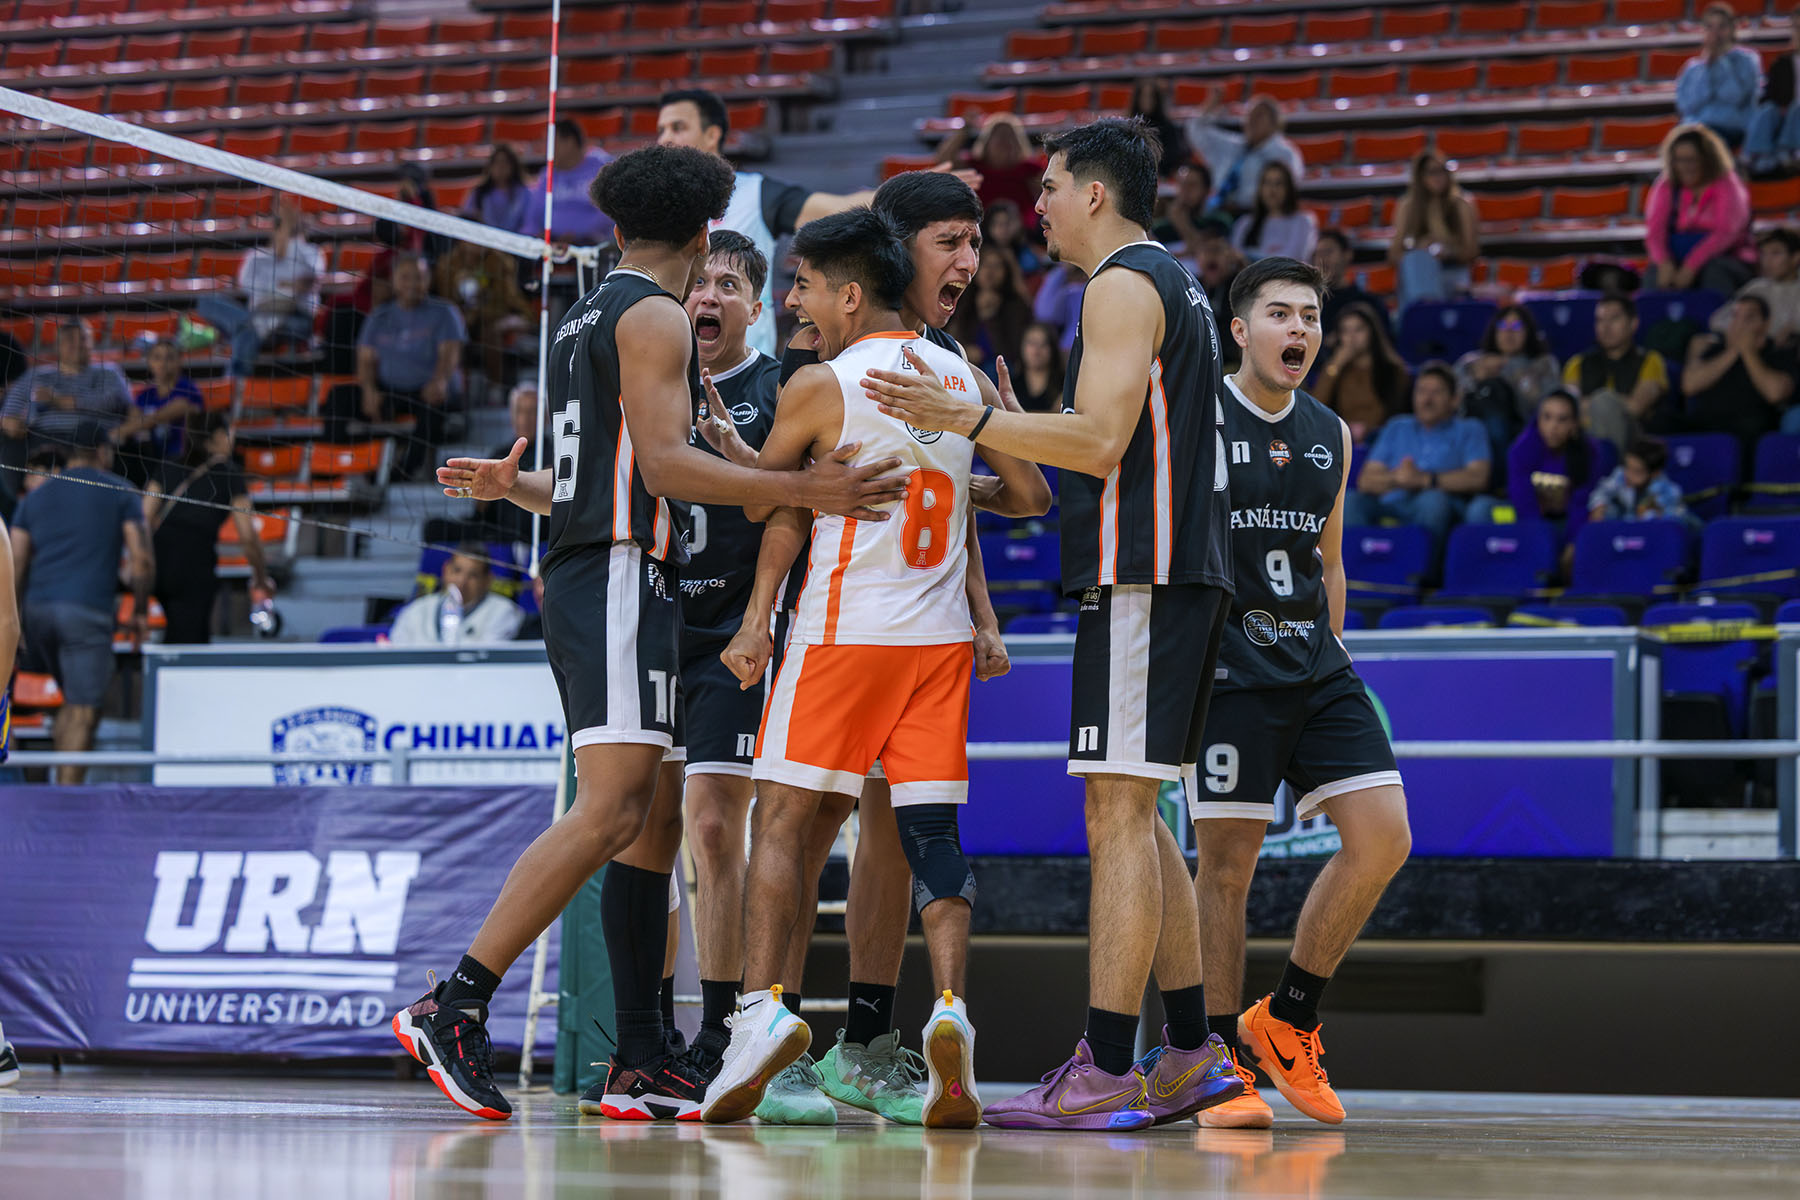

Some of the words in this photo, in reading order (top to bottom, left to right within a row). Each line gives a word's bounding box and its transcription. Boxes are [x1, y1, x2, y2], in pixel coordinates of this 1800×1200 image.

[900, 467, 956, 570] 8
[1265, 549, 1295, 597] 9
[1205, 743, 1240, 794] 9
[144, 851, 422, 956] URN
[125, 993, 387, 1028] UNIVERSIDAD
